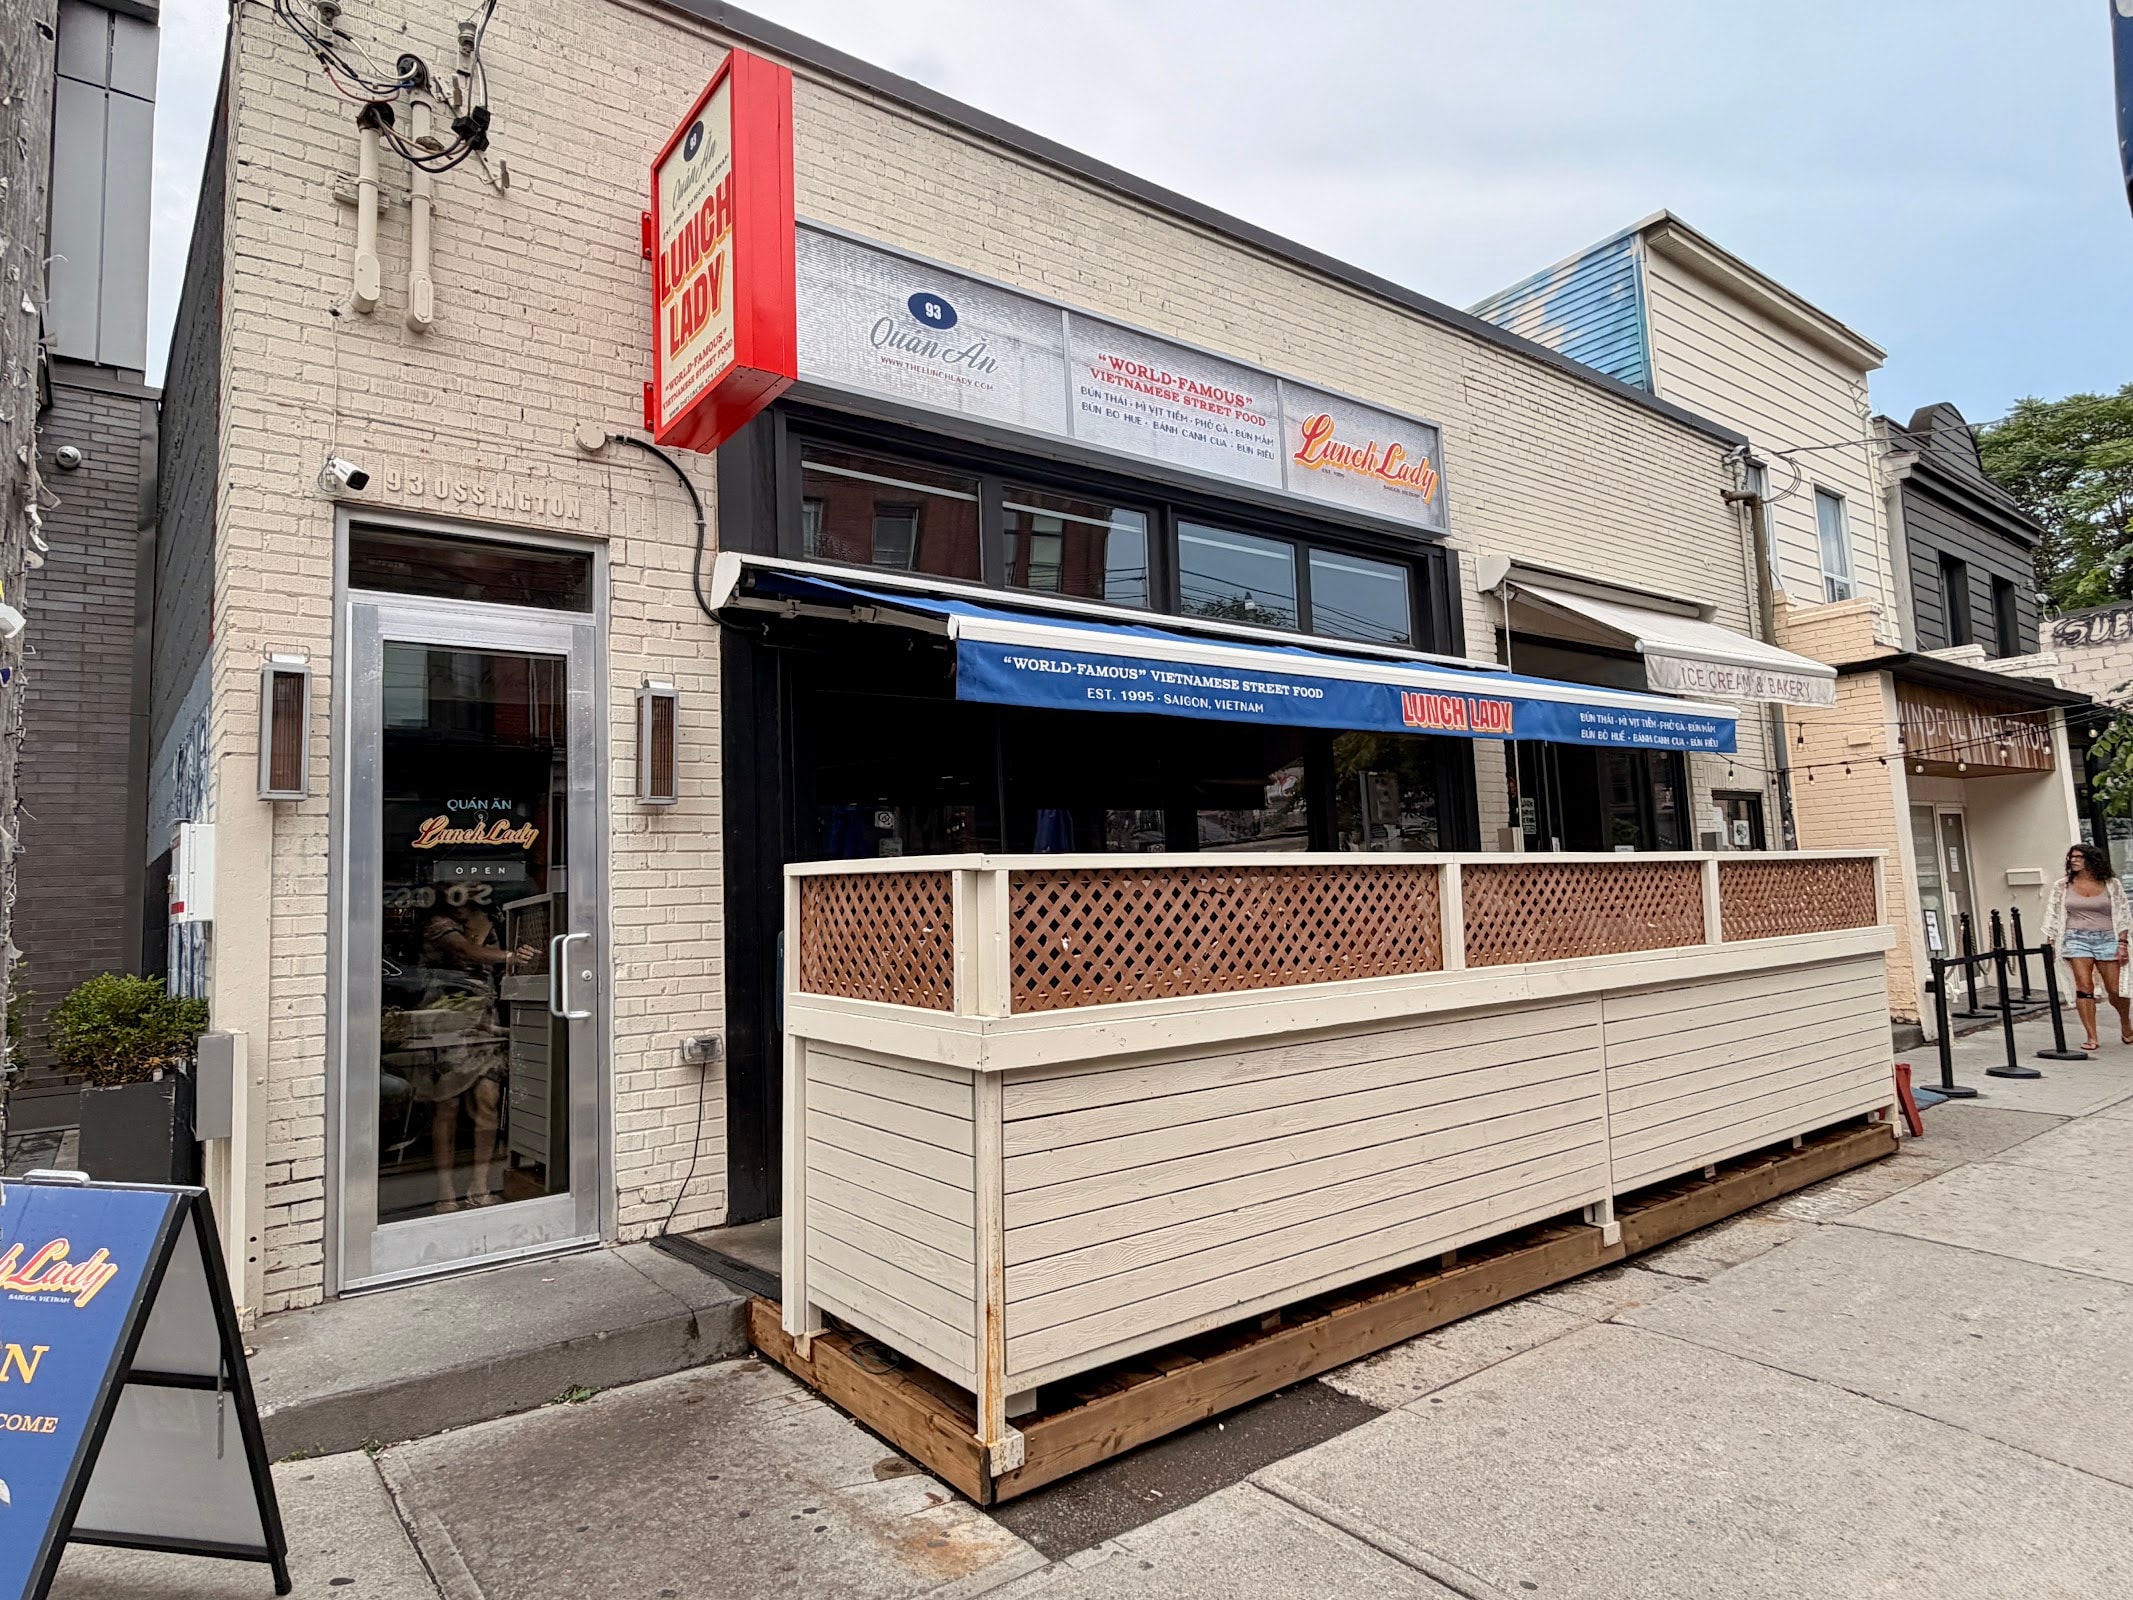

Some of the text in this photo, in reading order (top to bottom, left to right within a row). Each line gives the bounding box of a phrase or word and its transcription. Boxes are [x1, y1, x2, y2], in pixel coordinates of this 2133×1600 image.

[661, 171, 732, 305] LUNCH
[670, 251, 725, 361] LADY
[925, 302, 942, 320] 93
[870, 316, 1000, 374] Quán Ăn
[663, 338, 733, 410] VIETNAMESE STREET FOOD
[881, 355, 994, 392] WWW.THELUNCHLADY.COM
[1080, 386, 1101, 399] BÚN
[1104, 392, 1127, 406] THÁI
[1235, 429, 1253, 441] BÚN
[1090, 368, 1267, 427] VIETNAMESE STREET FOOD
[1081, 402, 1102, 414] BÚN
[1153, 420, 1178, 435] BÁNH
[1181, 429, 1207, 442] CANH
[1210, 437, 1228, 447] CUA
[1237, 443, 1254, 455] BÚN
[1293, 412, 1438, 504] Lunch Lady
[386, 469, 581, 520] 93 OSSINGTON
[1003, 655, 1324, 699] “WORLD-FAMOUS” VIETNAMESE STREET FOOD
[1087, 687, 1264, 713] EST. 1995 SAIGON, VIETNAM
[1681, 667, 1810, 698] ICE CREAM & BAKERY
[1400, 691, 1513, 734] LUNCH LADY
[446, 796, 512, 812] QUÁN ĂN
[411, 814, 539, 849] Lunch Lady
[455, 866, 506, 875] OPEN
[4, 1238, 118, 1308] Lady
[39, 1295, 71, 1304] VIETNAM
